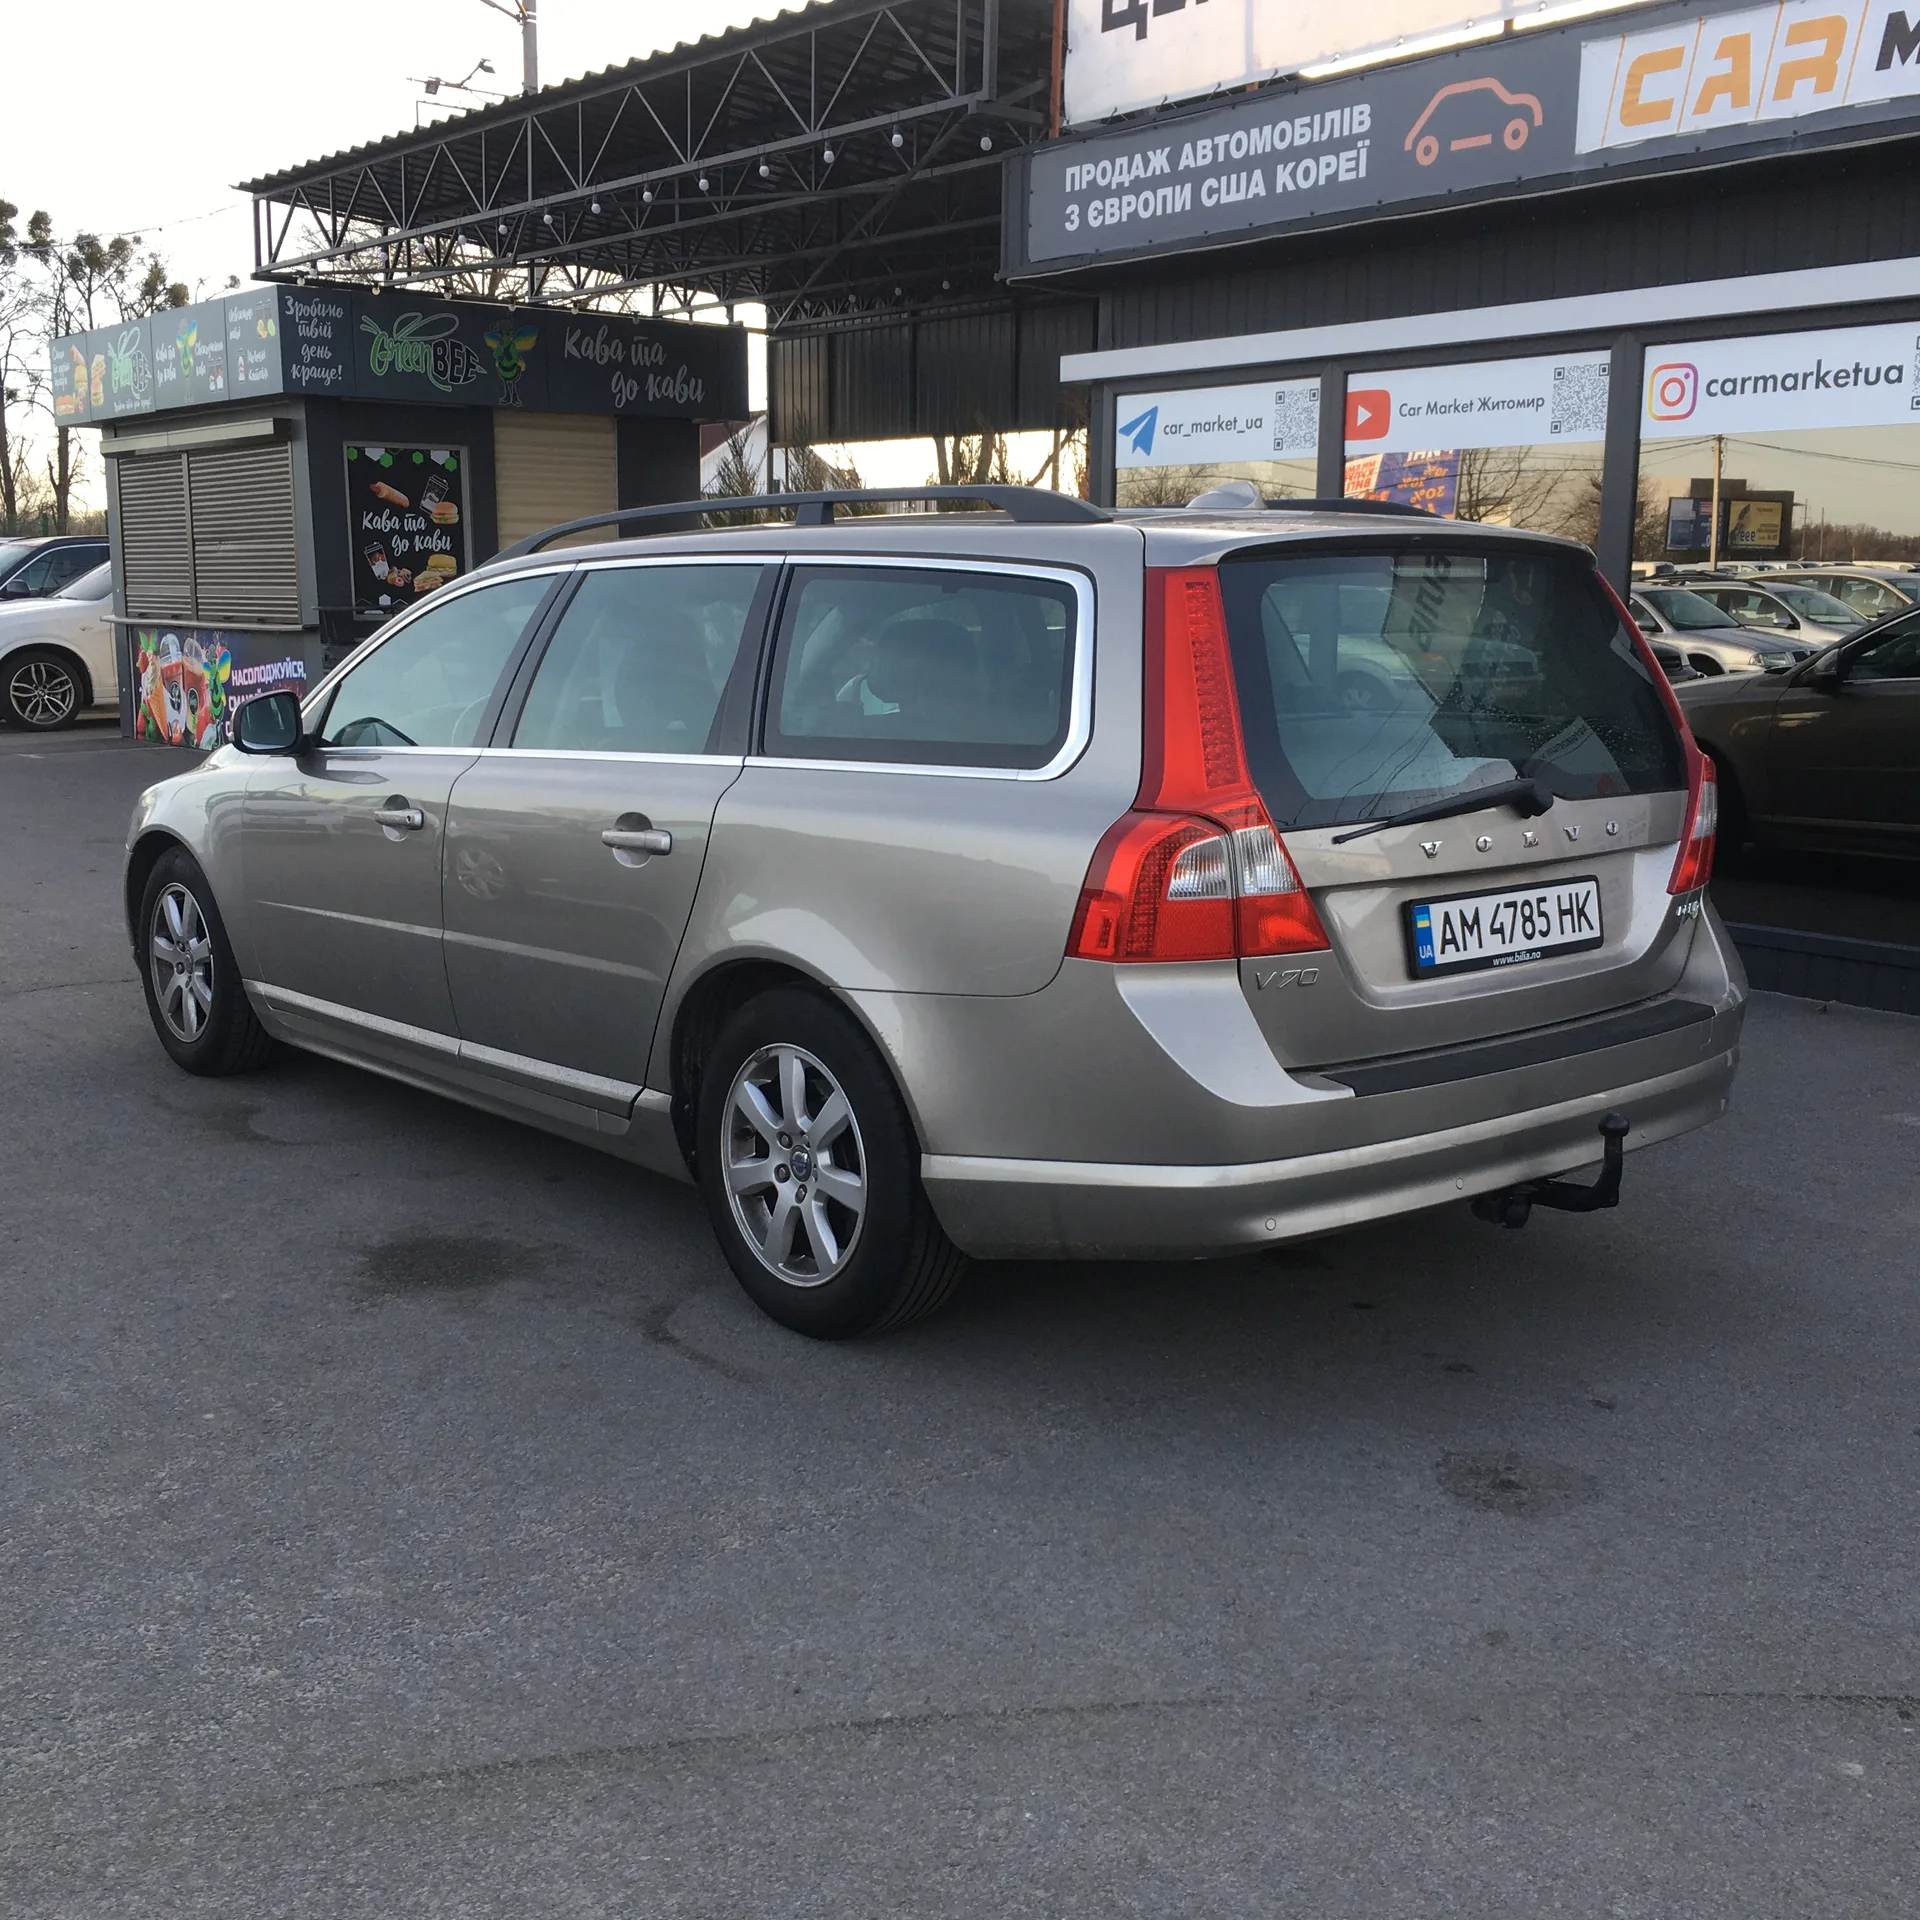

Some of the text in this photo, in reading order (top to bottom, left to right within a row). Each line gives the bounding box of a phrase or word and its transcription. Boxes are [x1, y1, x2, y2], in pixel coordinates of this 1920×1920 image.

[1619, 14, 1848, 128] CAR
[1065, 104, 1372, 193] ПРОДАЖ АВТОМОБІЛІВ
[1065, 139, 1371, 231] З ЄВРОПИ США КОРЕЇ
[285, 295, 344, 323] Зробимо
[298, 318, 333, 339] твій
[301, 343, 333, 364] день
[564, 325, 667, 367] Кава та
[290, 364, 343, 387] краще!
[611, 364, 705, 408] до кави
[1705, 359, 1904, 397] carmarketua
[1398, 396, 1545, 417] Car Market Житомир
[1163, 414, 1263, 437] car_market_ua
[362, 508, 428, 533] Кава та
[391, 528, 453, 556] до кави
[231, 657, 307, 687] НАСОЛОДЖУЙСЯ,
[1419, 820, 1620, 858] VOLVO
[1440, 890, 1594, 955] AM 4785 HK
[1419, 945, 1433, 959] UA
[1492, 951, 1541, 966] www.bilia.no
[1255, 967, 1320, 990] V70
